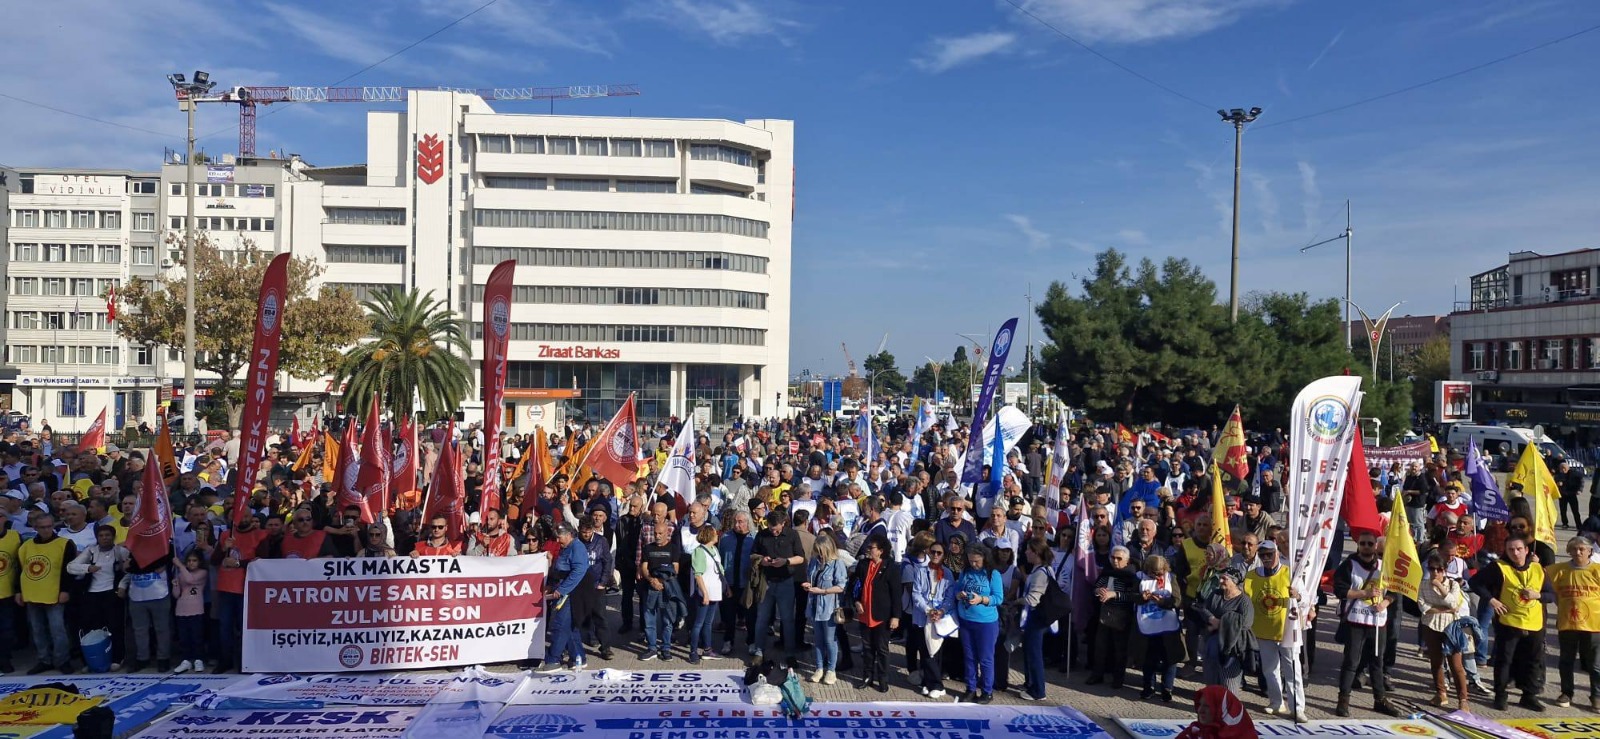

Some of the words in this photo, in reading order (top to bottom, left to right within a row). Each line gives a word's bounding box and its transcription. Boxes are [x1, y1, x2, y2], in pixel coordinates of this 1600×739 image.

[50, 186, 112, 194] VİDİNLİ
[538, 345, 573, 358] Ziraat
[574, 346, 620, 358] Bankası
[323, 561, 356, 580] ŞIK
[264, 587, 350, 604] PATRON
[355, 585, 382, 602] VE
[386, 585, 436, 601] SARI
[441, 578, 533, 600] SENDİKA
[331, 604, 433, 625] ZULMÜNE
[438, 605, 481, 621] SON
[370, 643, 459, 665] BİRTEK-SEN
[596, 687, 694, 696] EMEKÇİLERİ
[236, 711, 400, 726] KESK
[658, 709, 918, 719] GEÇİNEMYORUZ!
[484, 724, 587, 734] KESK
[633, 720, 720, 729] HALK
[845, 718, 955, 731] BÜTÇE
